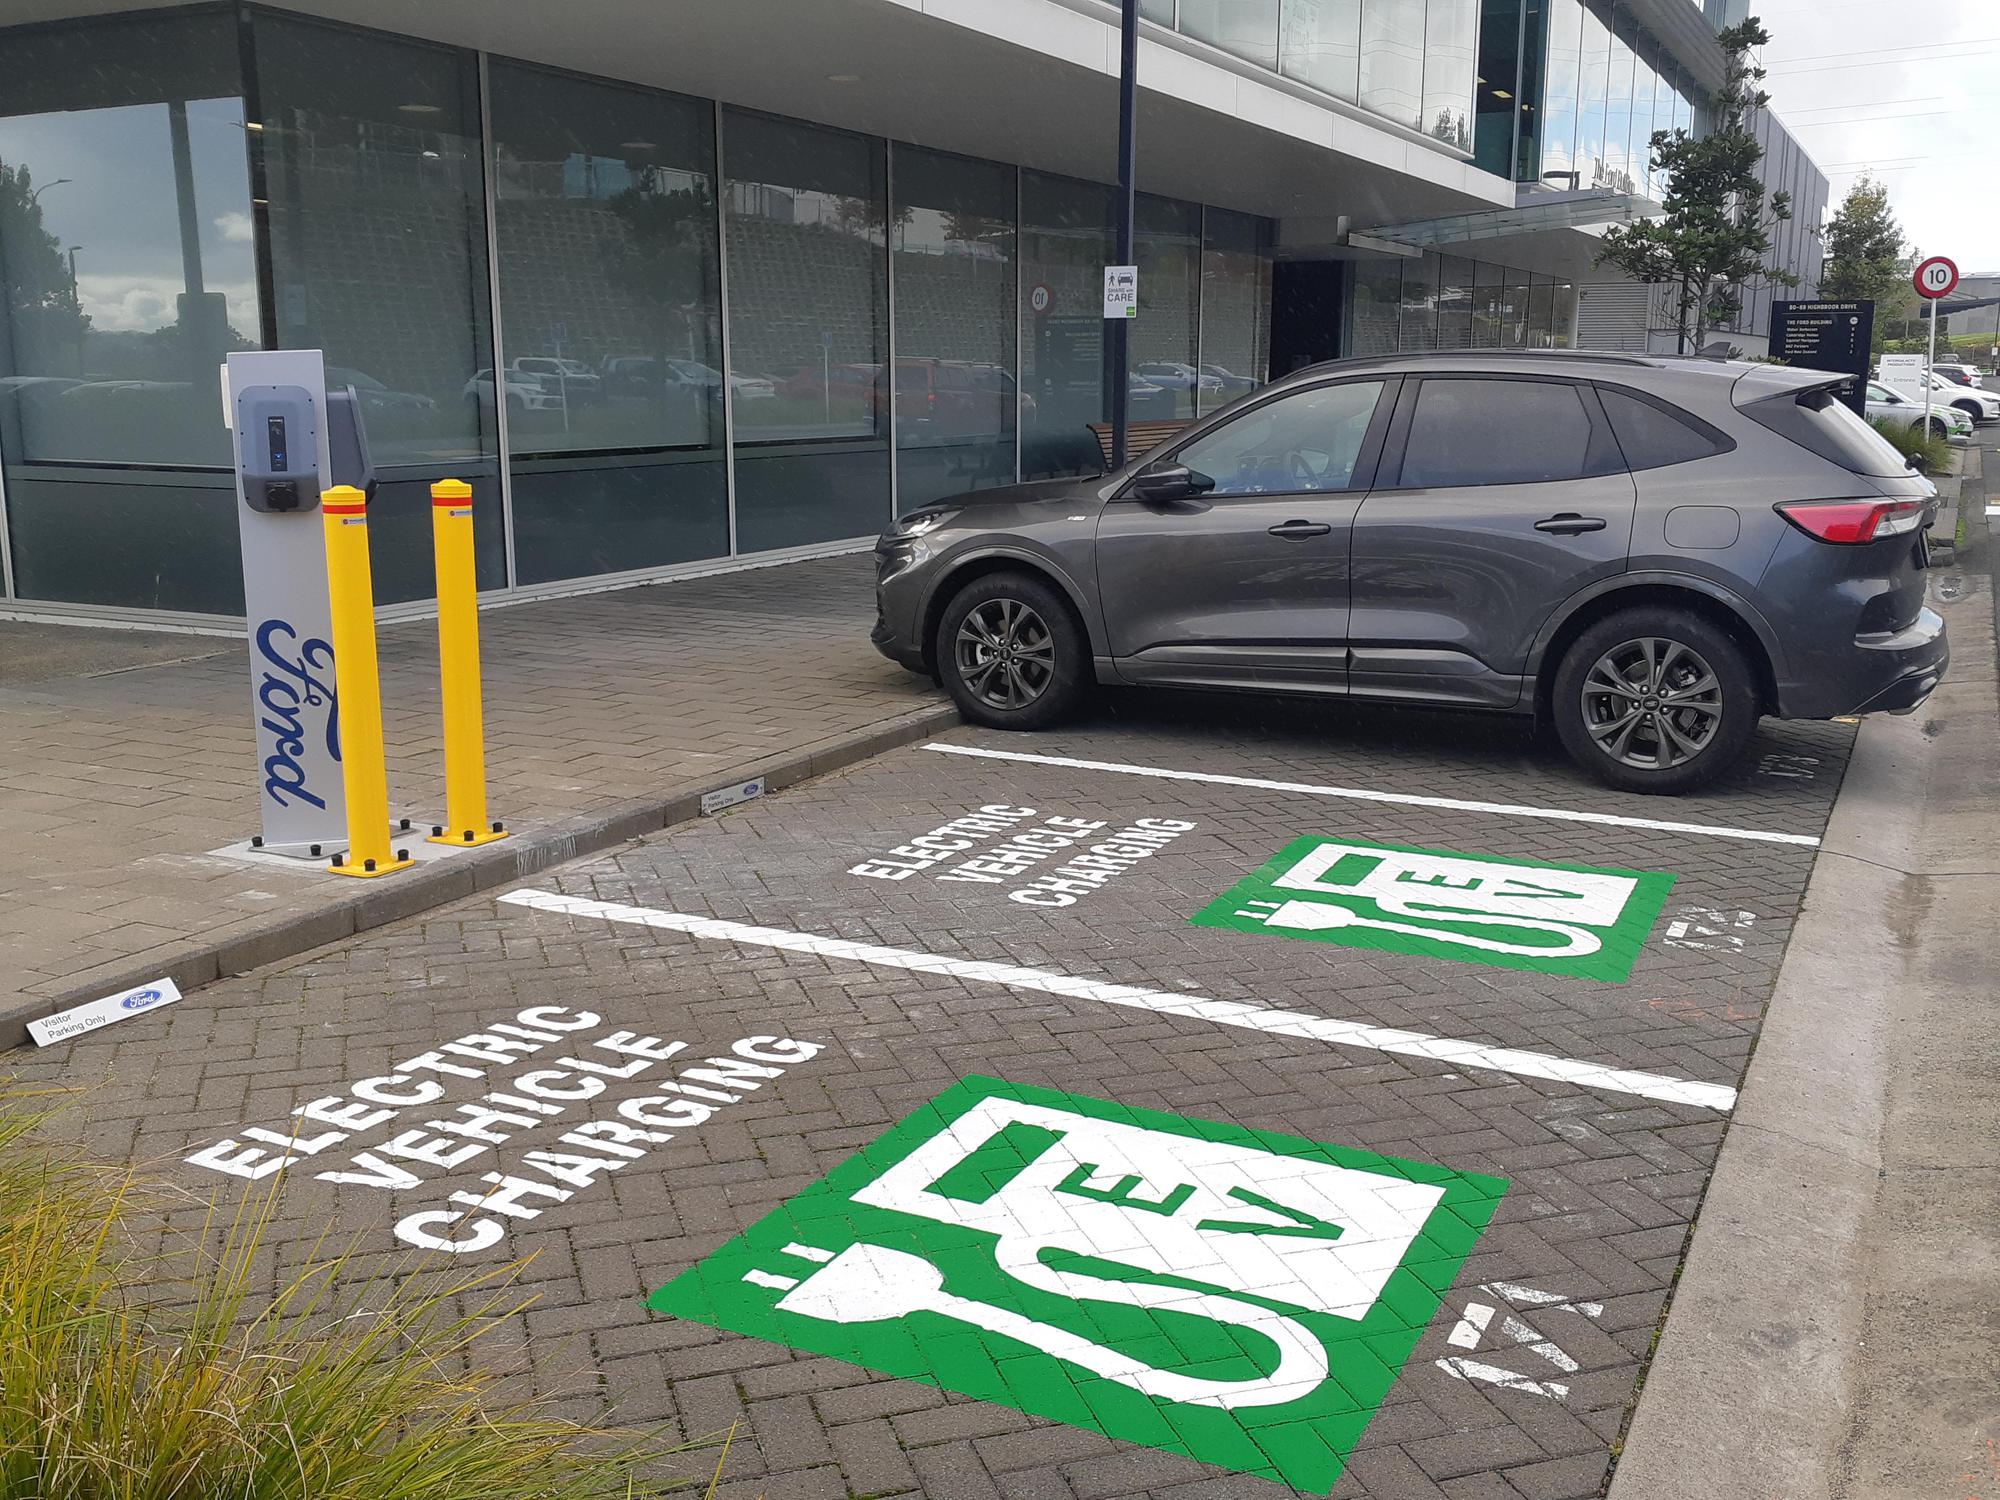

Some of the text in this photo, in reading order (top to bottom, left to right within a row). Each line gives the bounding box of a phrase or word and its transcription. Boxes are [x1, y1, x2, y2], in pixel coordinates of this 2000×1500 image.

[1107, 293, 1133, 302] CARE
[1929, 269, 1947, 284] 10
[256, 619, 342, 810] Ford
[847, 805, 1037, 880] ELECTRIC
[936, 815, 1107, 883] VEHICLE
[1008, 818, 1197, 907] CHARGING
[1396, 868, 1586, 899] EV
[41, 1013, 72, 1028] Visitor
[48, 1014, 106, 1039] Parking Only
[129, 992, 155, 1008] Ford
[184, 1005, 601, 1180] ELECTRIC
[314, 1030, 690, 1190] VEHICLE
[394, 1034, 826, 1254] CHARGING
[1052, 1161, 1345, 1241] EV
